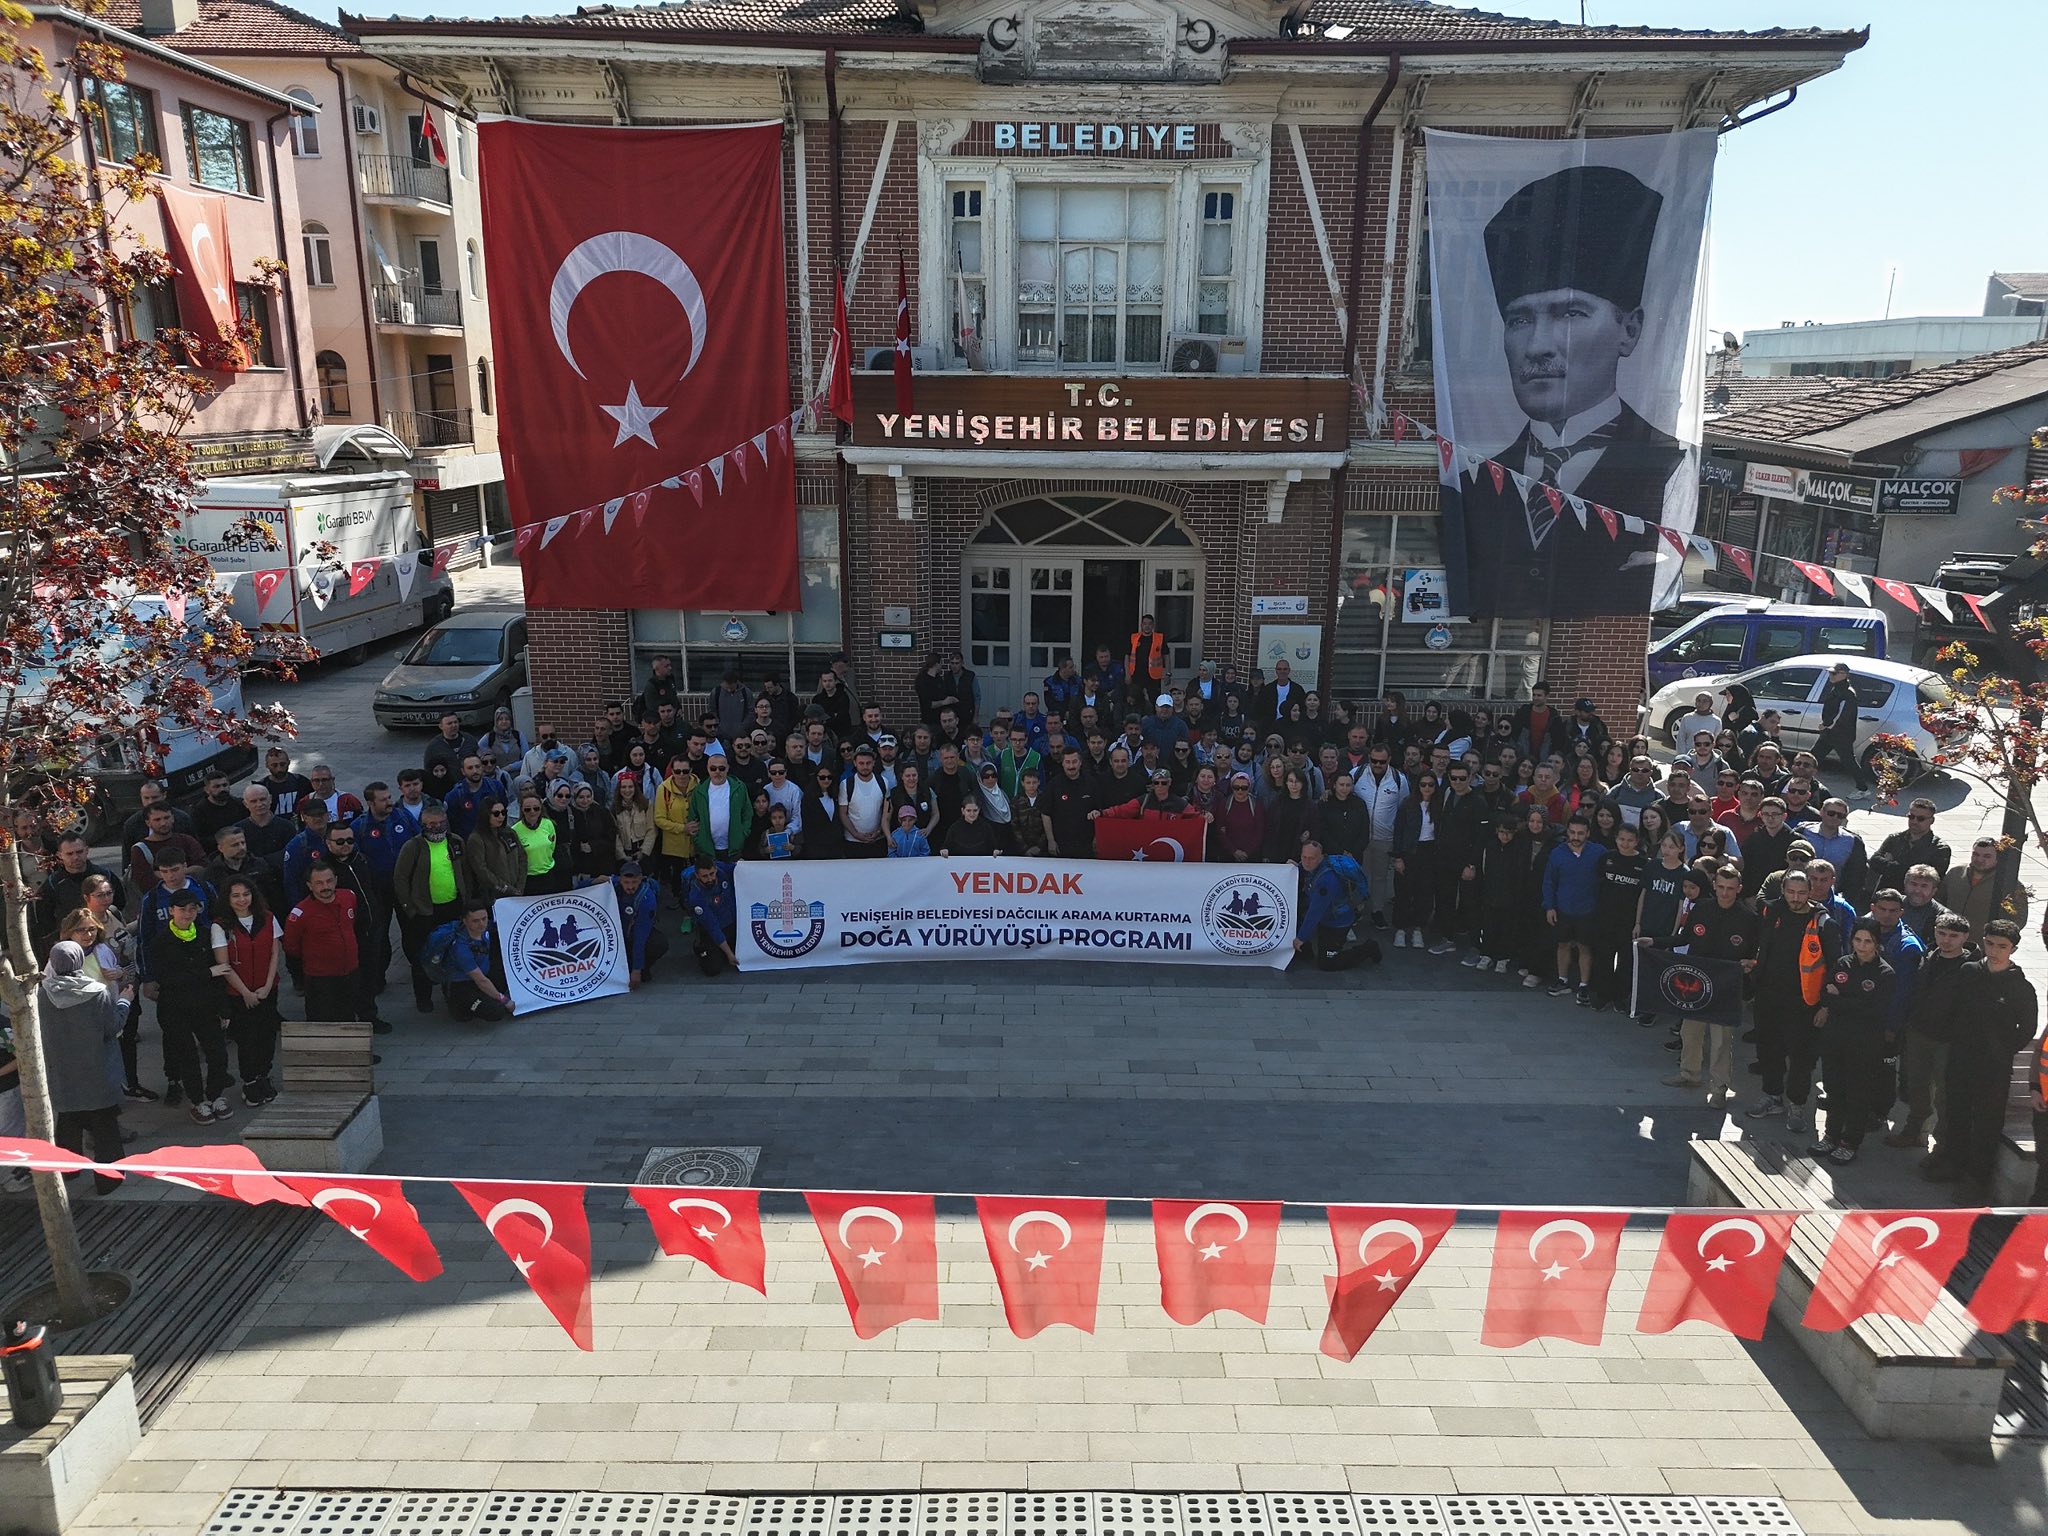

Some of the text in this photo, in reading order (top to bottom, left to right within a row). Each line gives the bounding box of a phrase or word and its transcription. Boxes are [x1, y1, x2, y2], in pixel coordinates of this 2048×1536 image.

[1065, 383, 1133, 407] T.C.
[876, 409, 1325, 445] YENİŞEHİR BELEDİYESİ
[1807, 479, 1852, 504] MALÇOK
[1884, 482, 1955, 498] MALÇOK
[325, 508, 375, 529] Garanti BBVA
[188, 539, 236, 552] Garanti
[951, 872, 1083, 895] YENDAK
[841, 906, 1192, 924] YENİŞEHİR BELEDİYESİ DAĞCILIK ARAMA KURTARMA
[1204, 877, 1287, 930] YENİŞEHİR BELEDİYESİ ARAMA KURTARMA
[511, 898, 614, 973] YENİŞEHİR BELEDİYESİ ARAMA KURTARMA
[759, 936, 794, 956] YENİŞEHİR
[795, 922, 822, 954] BELEDİYESİ
[840, 923, 1192, 950] DOĞA YÜRÜYÜŞÜ PROGRAMI
[1222, 929, 1268, 939] YENDAK
[1215, 939, 1240, 954] SEARCH
[1250, 942, 1274, 954] RESCUE
[538, 960, 597, 980] YENDAK
[559, 975, 579, 985] 2025
[533, 984, 567, 998] SEARCH
[578, 971, 606, 994] RESCUE
